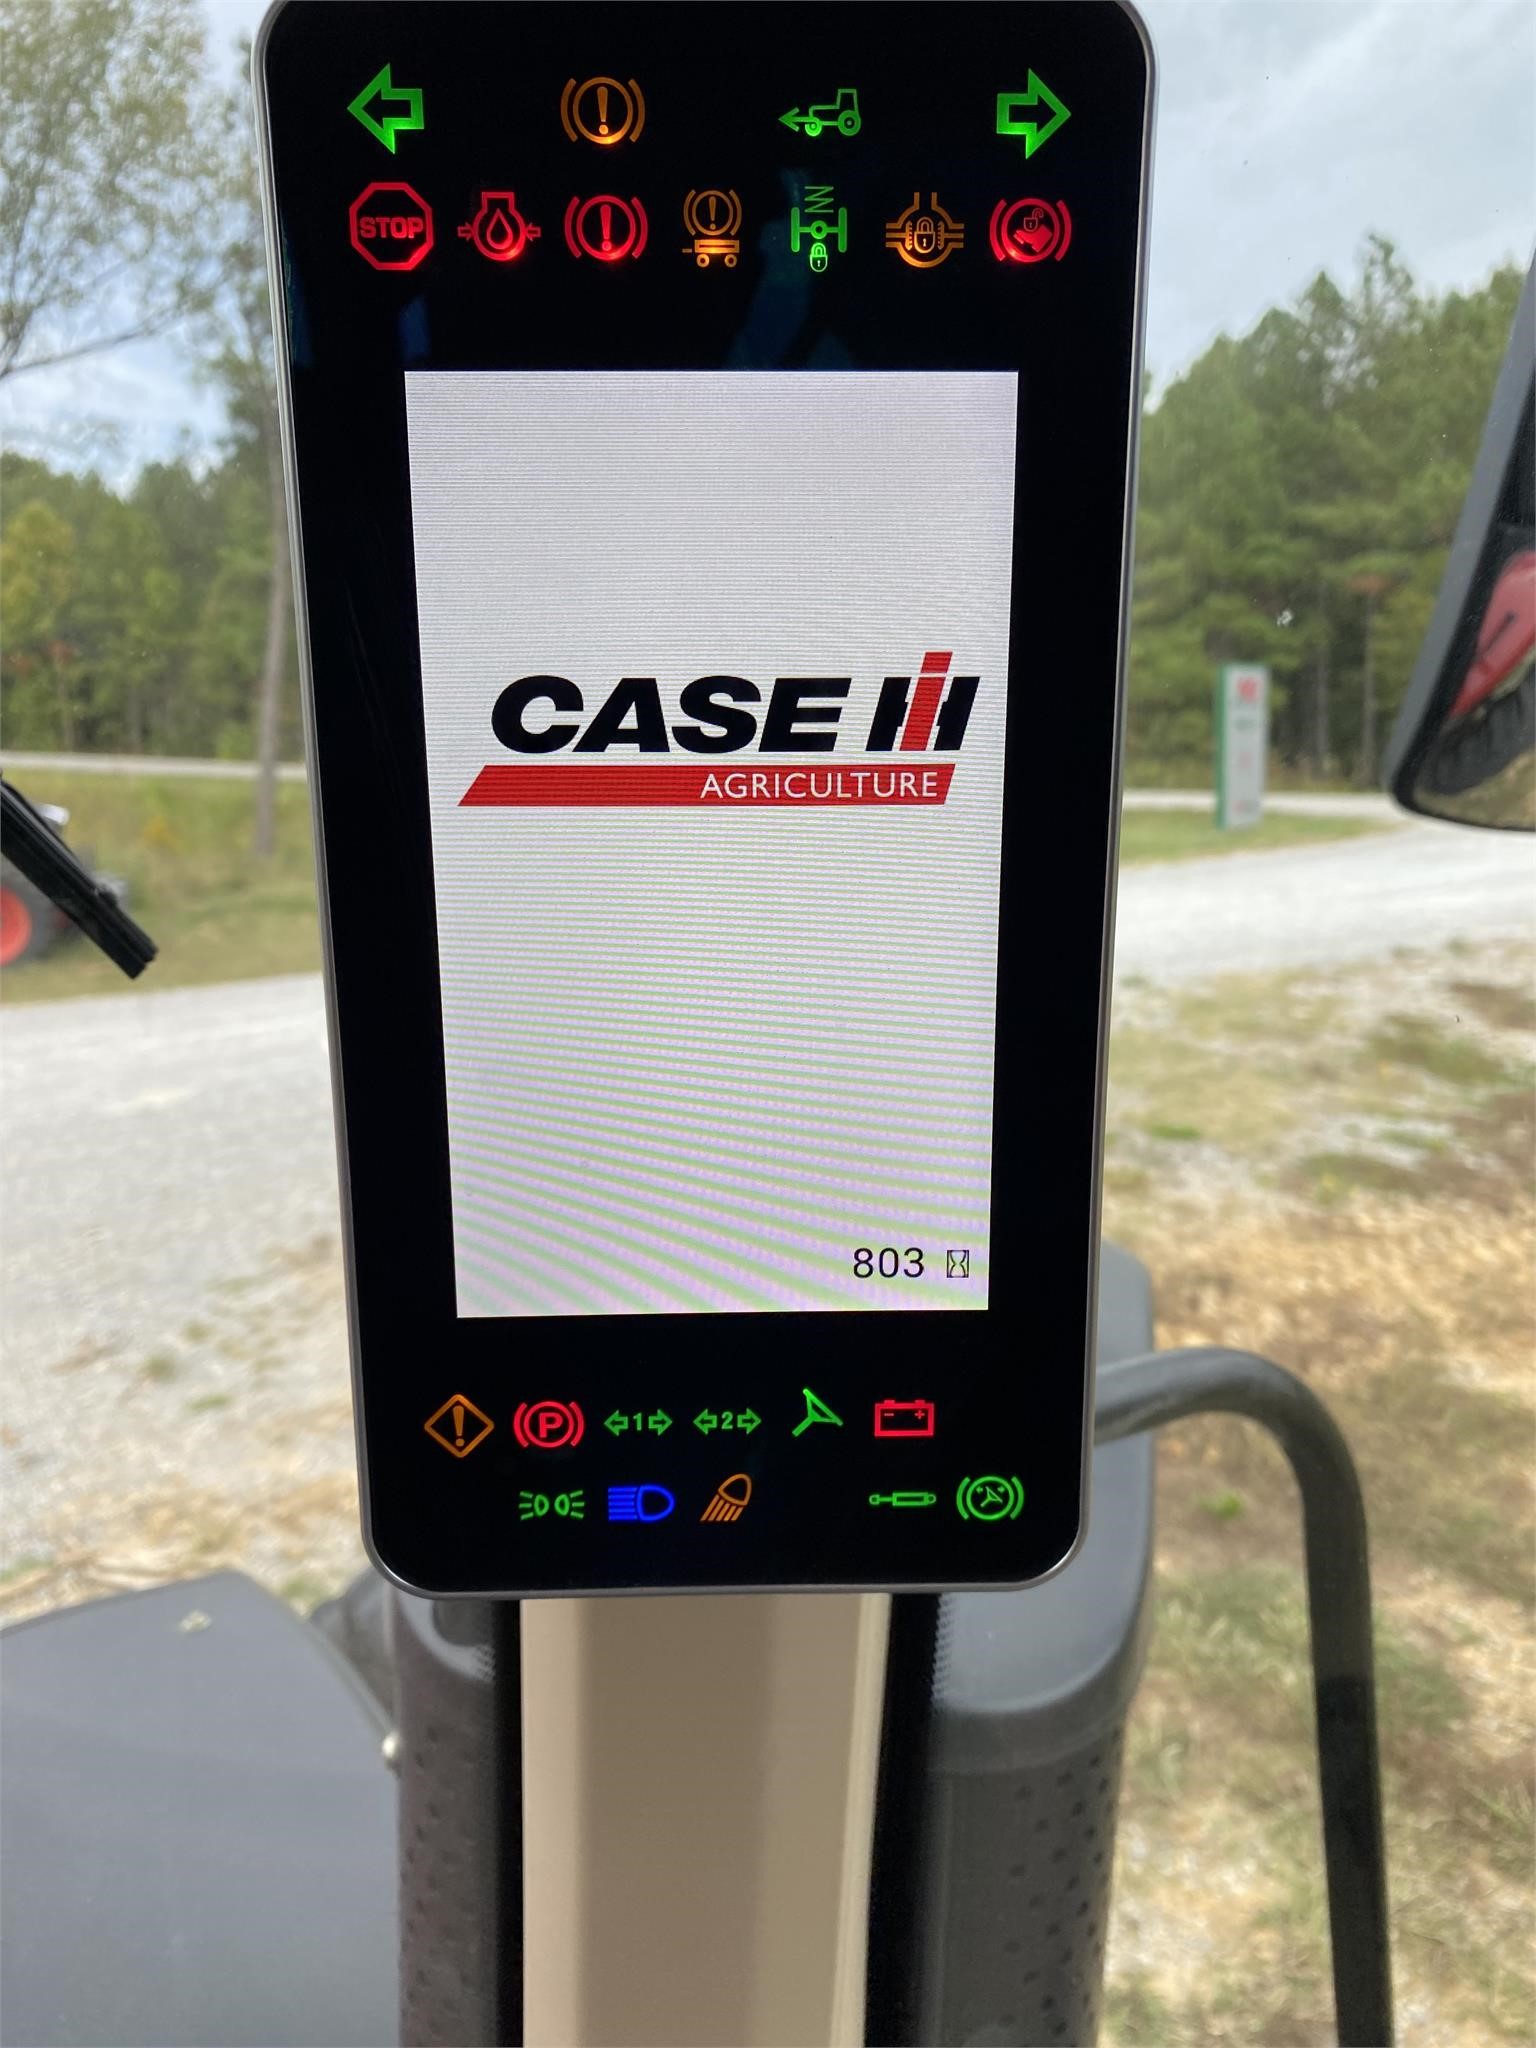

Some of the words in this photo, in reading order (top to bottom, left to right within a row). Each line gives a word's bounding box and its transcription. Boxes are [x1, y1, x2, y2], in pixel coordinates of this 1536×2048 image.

[359, 217, 424, 239] STOP
[491, 675, 852, 753] CASE
[700, 772, 938, 799] AGRICULTURE
[853, 1247, 924, 1278] 803
[539, 1412, 564, 1438] P
[721, 1411, 734, 1430] 2
